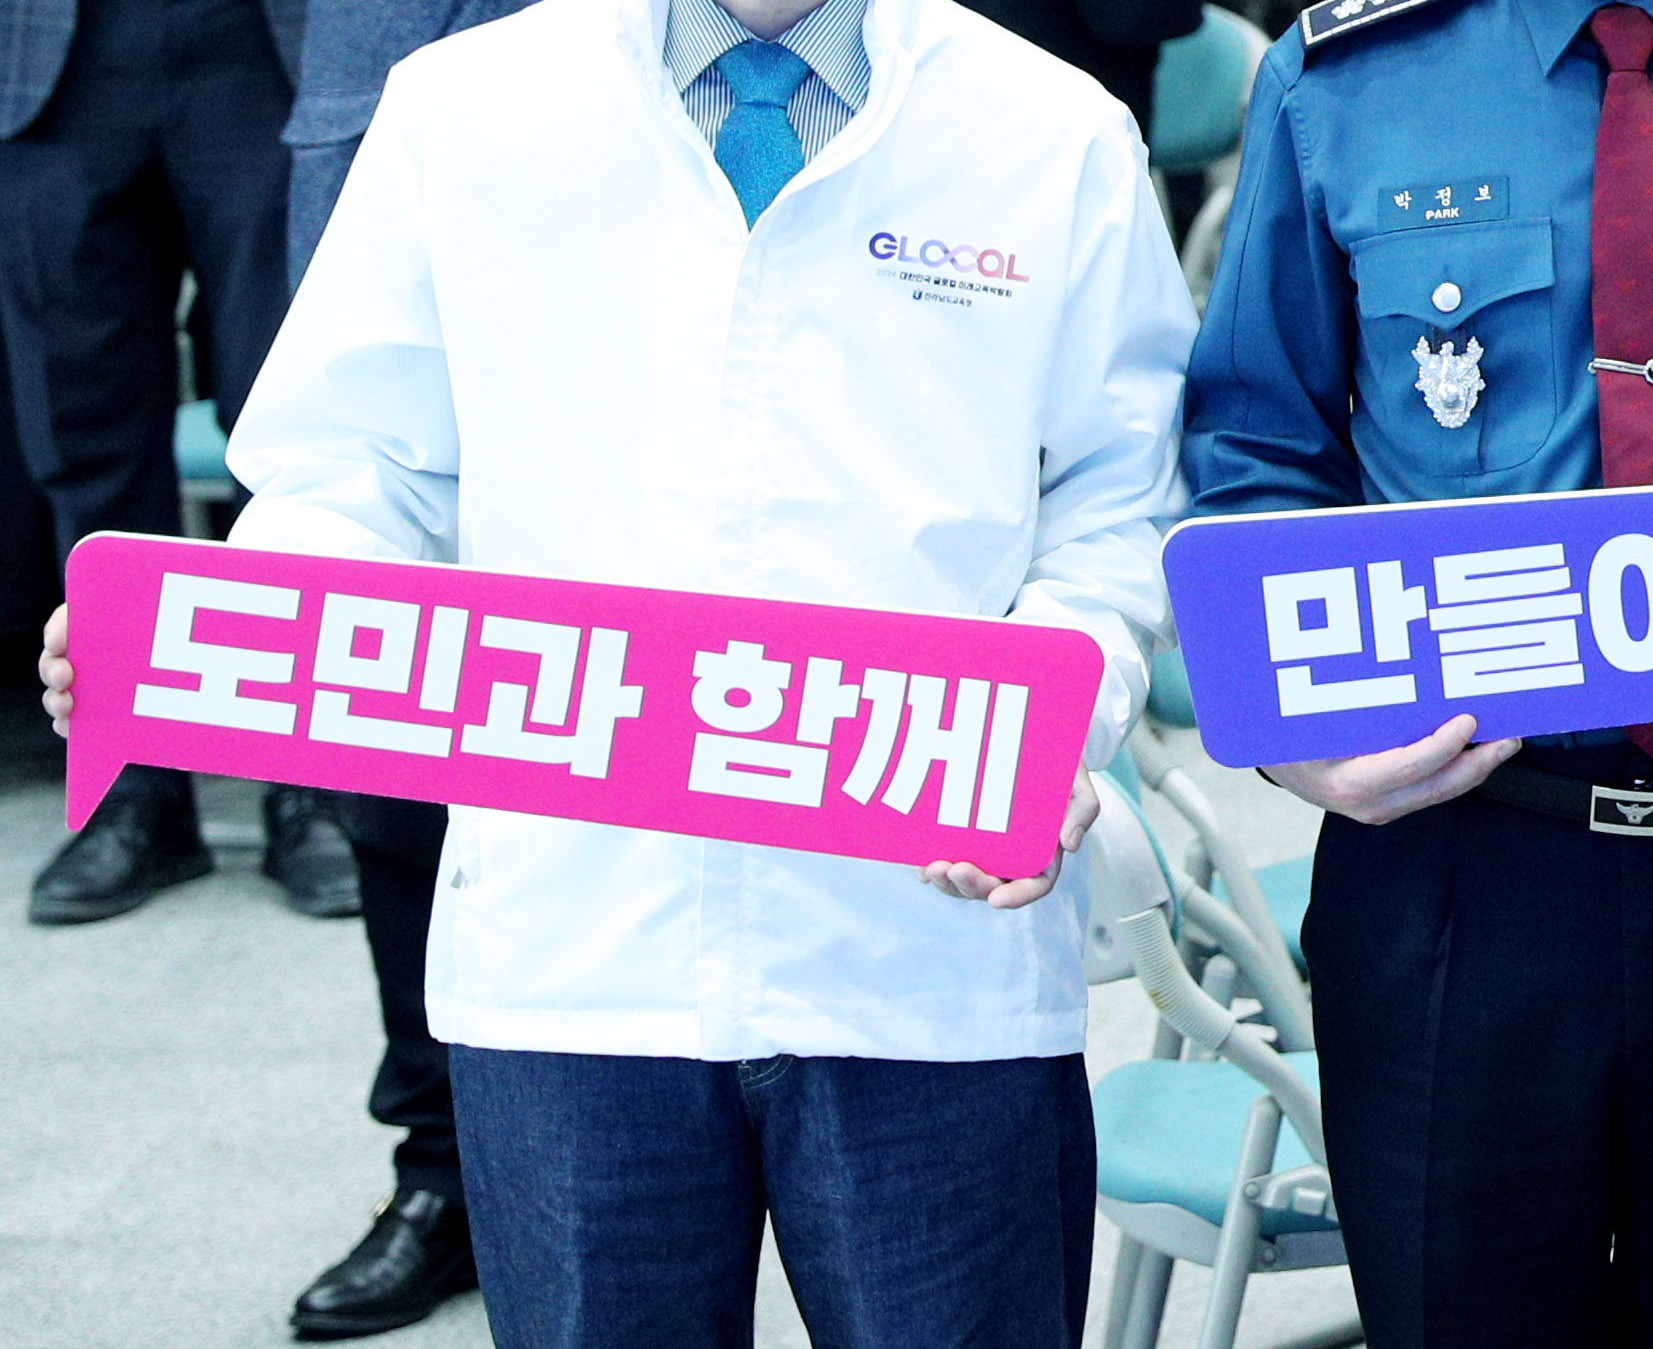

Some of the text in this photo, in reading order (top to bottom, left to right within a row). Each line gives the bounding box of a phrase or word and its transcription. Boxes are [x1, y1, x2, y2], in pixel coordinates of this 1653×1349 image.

[1425, 207, 1460, 221] PARK
[869, 232, 1029, 283] GLOCAL
[132, 571, 1029, 834] 도민과 함께
